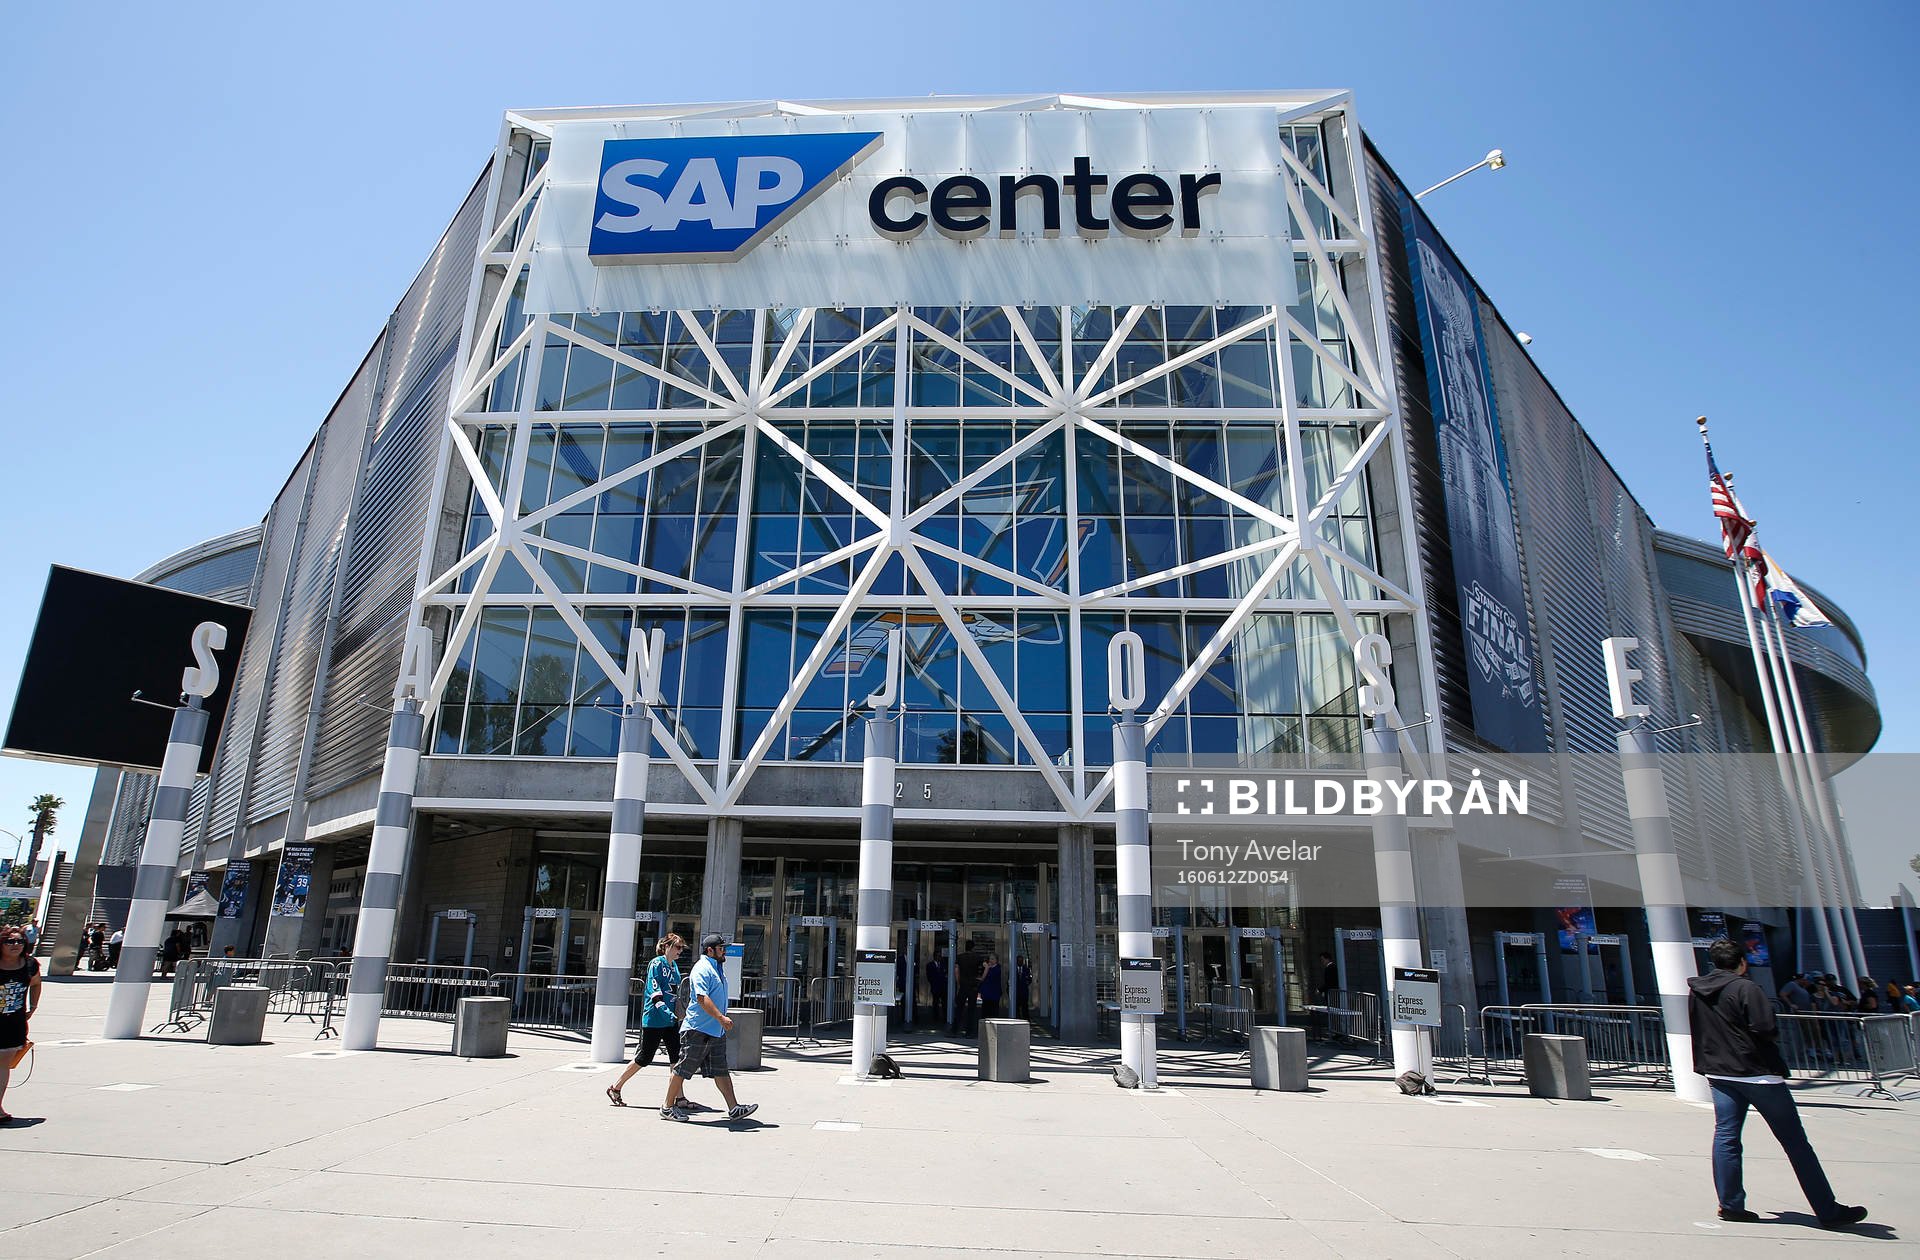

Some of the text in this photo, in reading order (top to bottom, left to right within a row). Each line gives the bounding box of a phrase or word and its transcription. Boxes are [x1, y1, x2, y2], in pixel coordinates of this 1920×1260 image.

[595, 156, 1221, 239] SAP center
[1473, 586, 1517, 631] STANLEY CUP
[1468, 596, 1530, 669] FINAL
[296, 877, 308, 887] 39
[858, 976, 881, 986] Express
[857, 986, 883, 996] Entrance
[1124, 984, 1148, 995] Express
[1124, 994, 1151, 1004] Entrance
[1397, 994, 1424, 1006] Express
[1397, 1004, 1427, 1016] Entrance
